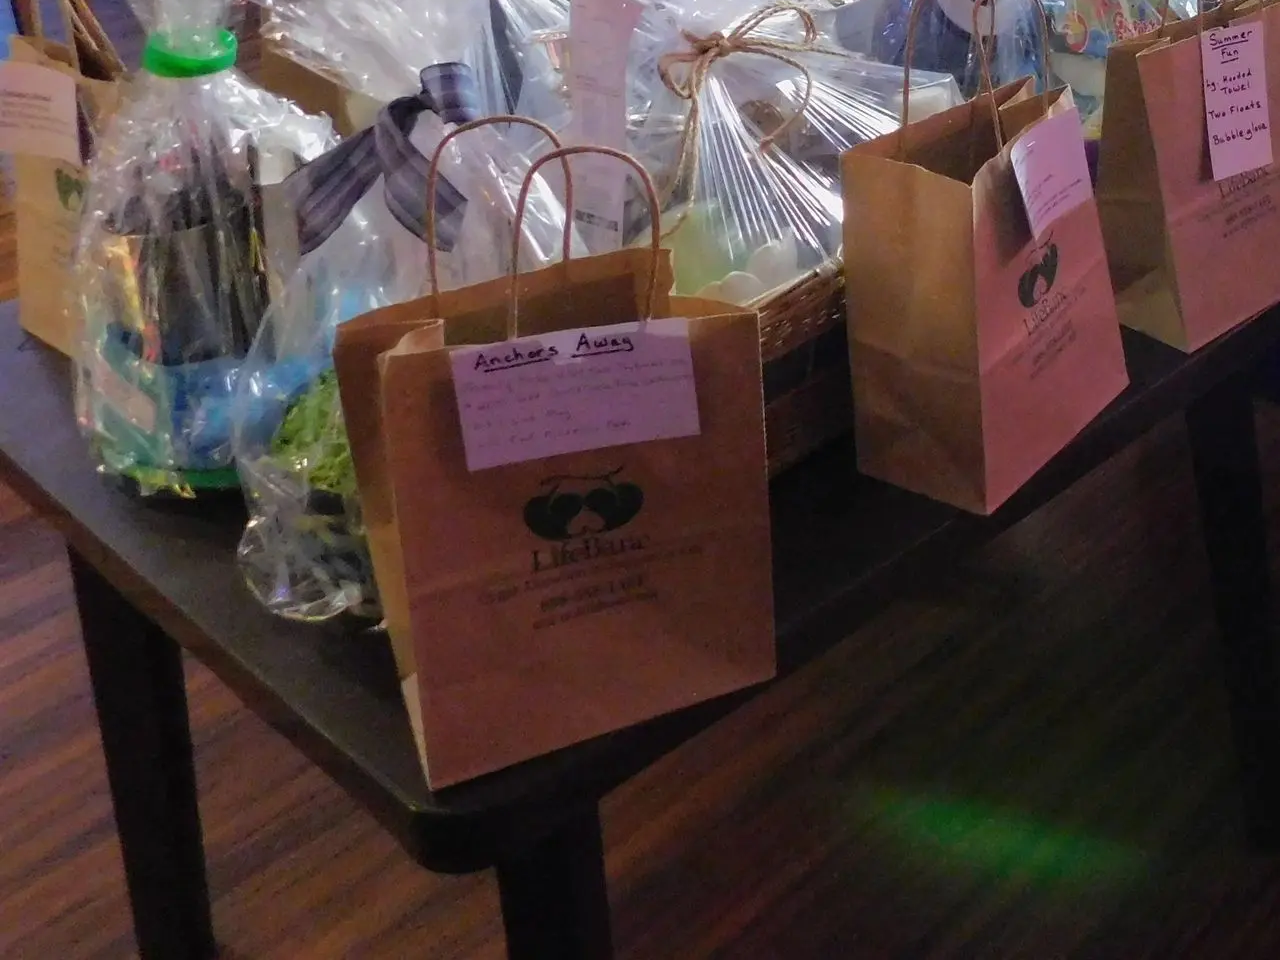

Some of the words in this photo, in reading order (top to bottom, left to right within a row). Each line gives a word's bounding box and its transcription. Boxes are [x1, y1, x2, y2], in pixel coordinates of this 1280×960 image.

[1208, 29, 1253, 47] Summer
[1220, 47, 1239, 60] Fun
[1219, 80, 1250, 96] Towel
[1208, 109, 1226, 120] Two
[1229, 100, 1262, 115] Floats
[474, 344, 559, 371] Anchors
